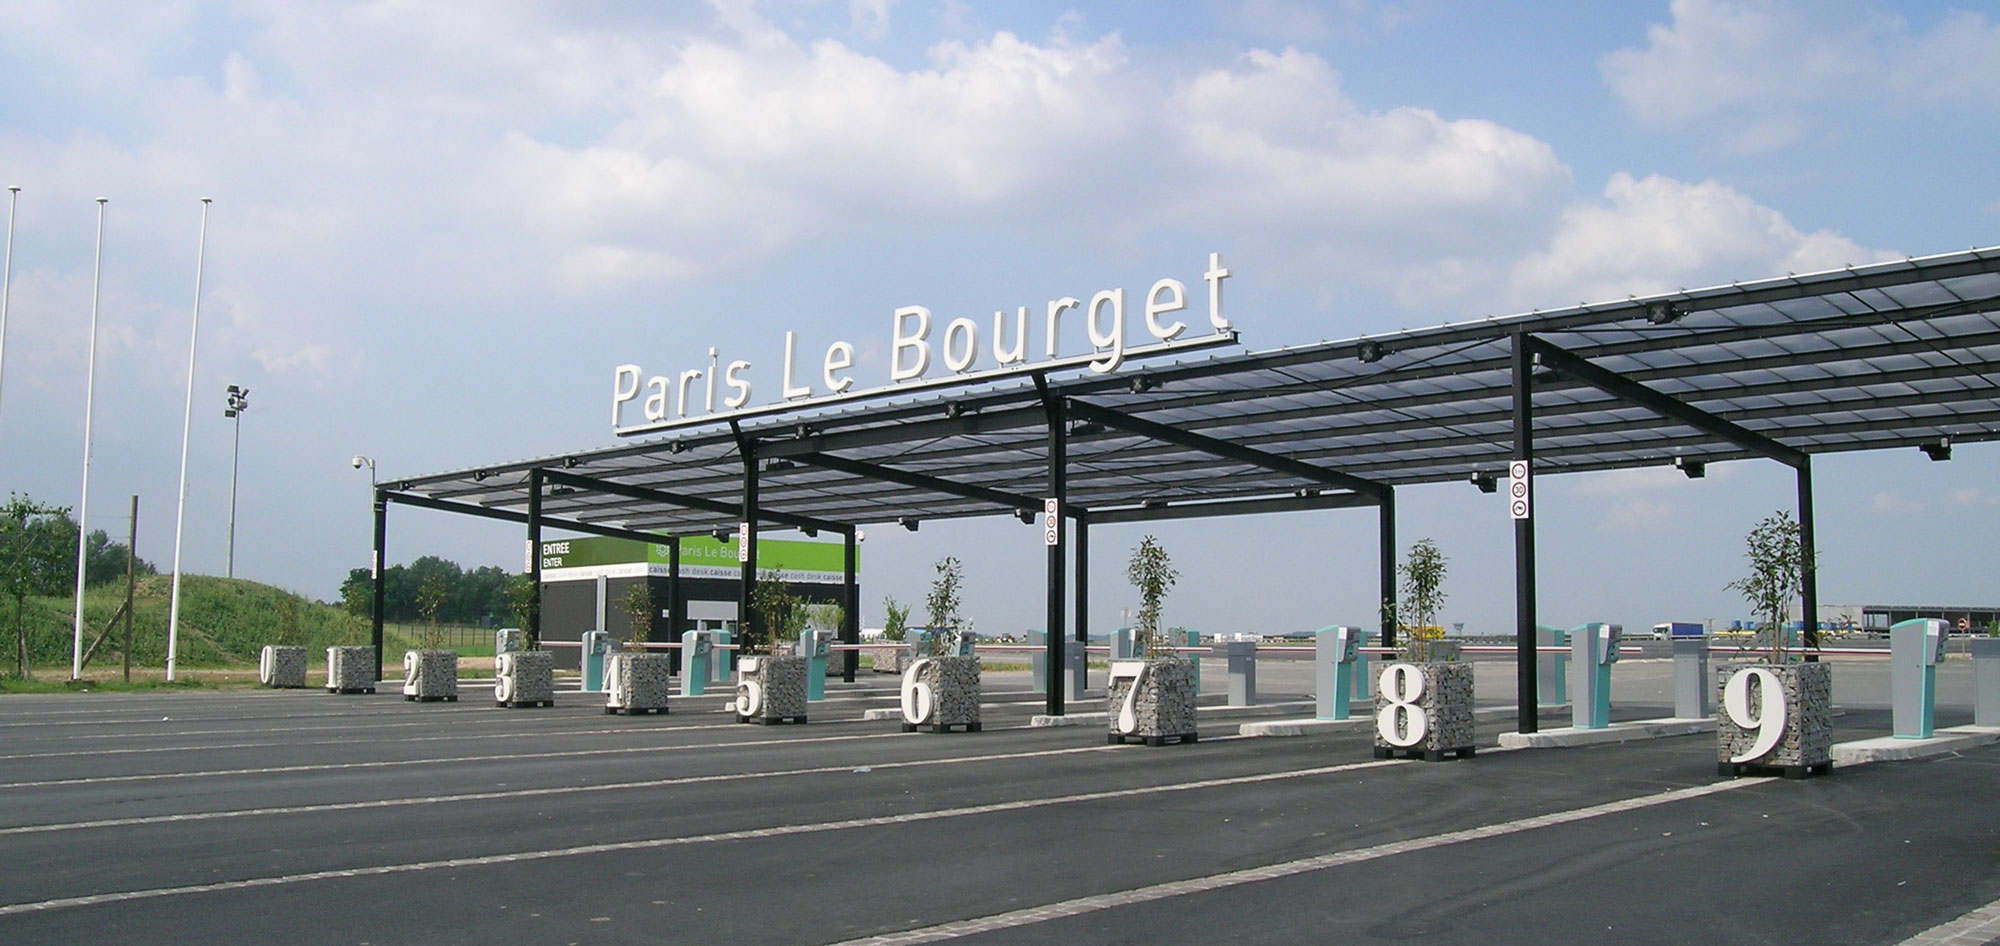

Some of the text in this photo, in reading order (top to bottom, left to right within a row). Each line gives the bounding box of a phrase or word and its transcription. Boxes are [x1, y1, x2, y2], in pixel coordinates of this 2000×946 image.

[612, 252, 1233, 426] Paris Le Bourget
[543, 542, 570, 555] ENTREE
[543, 557, 563, 567] ENTER
[679, 545, 701, 557] aris
[704, 546, 718, 558] Le
[691, 568, 708, 576] desk
[709, 569, 731, 577] caisse
[790, 571, 805, 579] cash
[807, 572, 822, 580] desk
[823, 573, 843, 581] caisse
[259, 645, 274, 684] 0
[326, 647, 338, 689] 1
[403, 651, 421, 696] 2
[494, 653, 513, 703] 3
[601, 656, 626, 708] 4
[736, 656, 763, 717] 5
[901, 658, 934, 725] 6
[1108, 661, 1146, 735] 7
[1378, 663, 1428, 747] 8
[1723, 667, 1788, 763] 9
